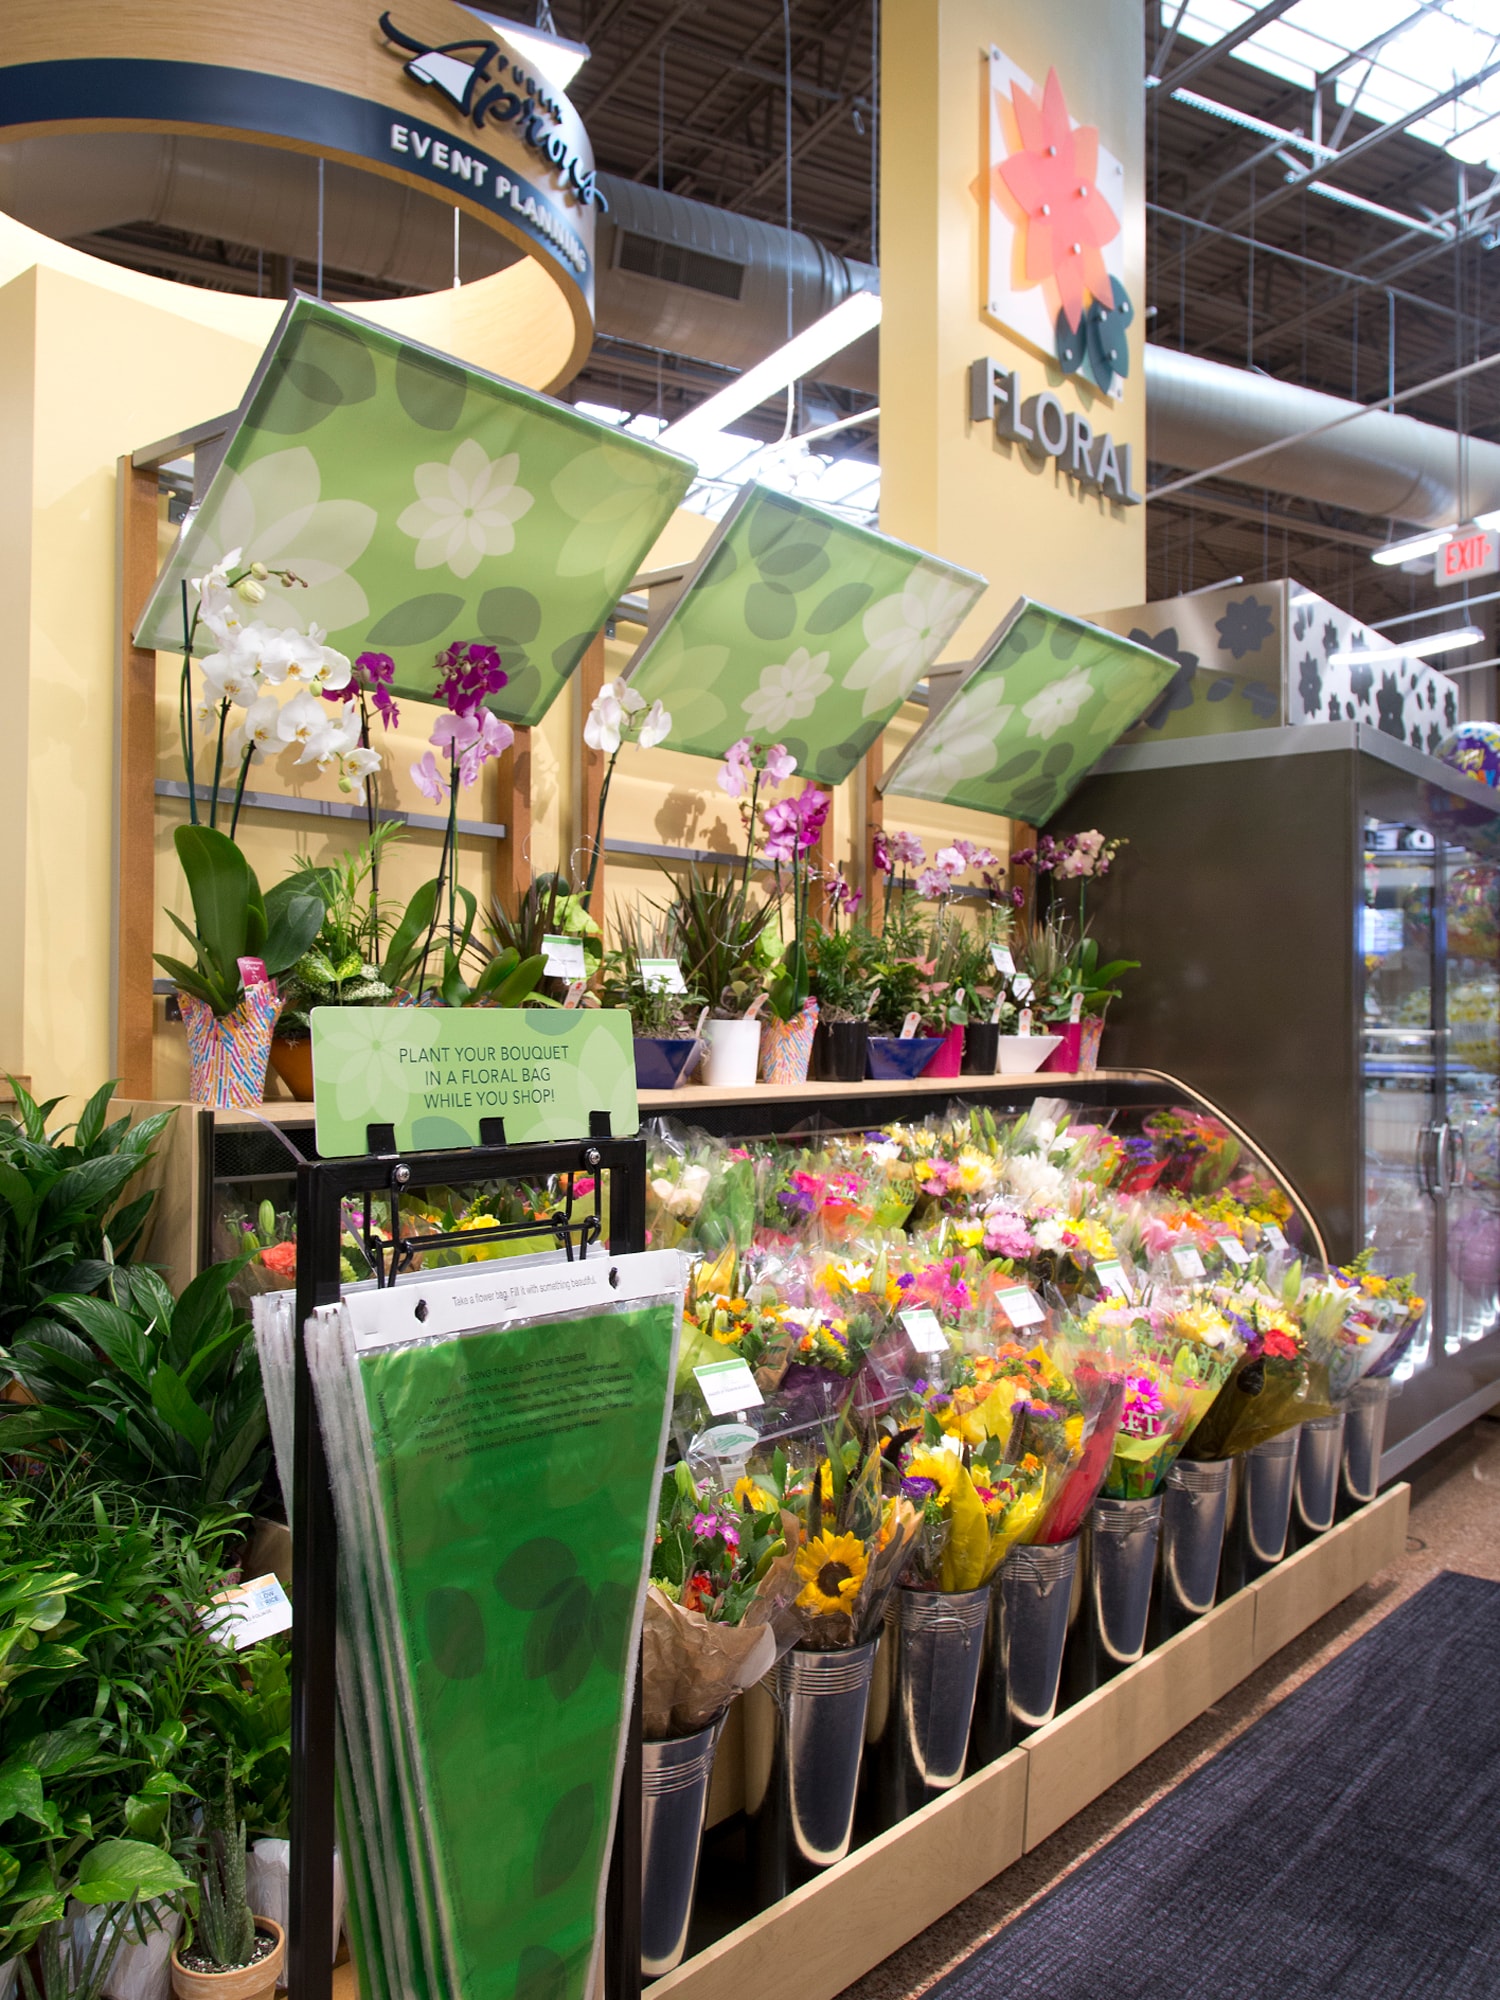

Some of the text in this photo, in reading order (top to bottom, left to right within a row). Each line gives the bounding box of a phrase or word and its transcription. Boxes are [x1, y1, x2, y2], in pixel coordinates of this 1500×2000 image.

[390, 123, 587, 273] EVENT PLANNING
[972, 356, 1142, 506] FLORAL
[1445, 532, 1488, 576] EXIT
[400, 1045, 568, 1063] PLANT YOUR BOUQUET
[425, 1067, 550, 1086] IN A FLORAL BAG
[424, 1089, 555, 1109] WHILE YOU SHOP!
[452, 1296, 469, 1307] Take
[475, 1292, 494, 1303] flower
[510, 1286, 519, 1297] Fill
[526, 1284, 539, 1295] with
[540, 1280, 570, 1293] something
